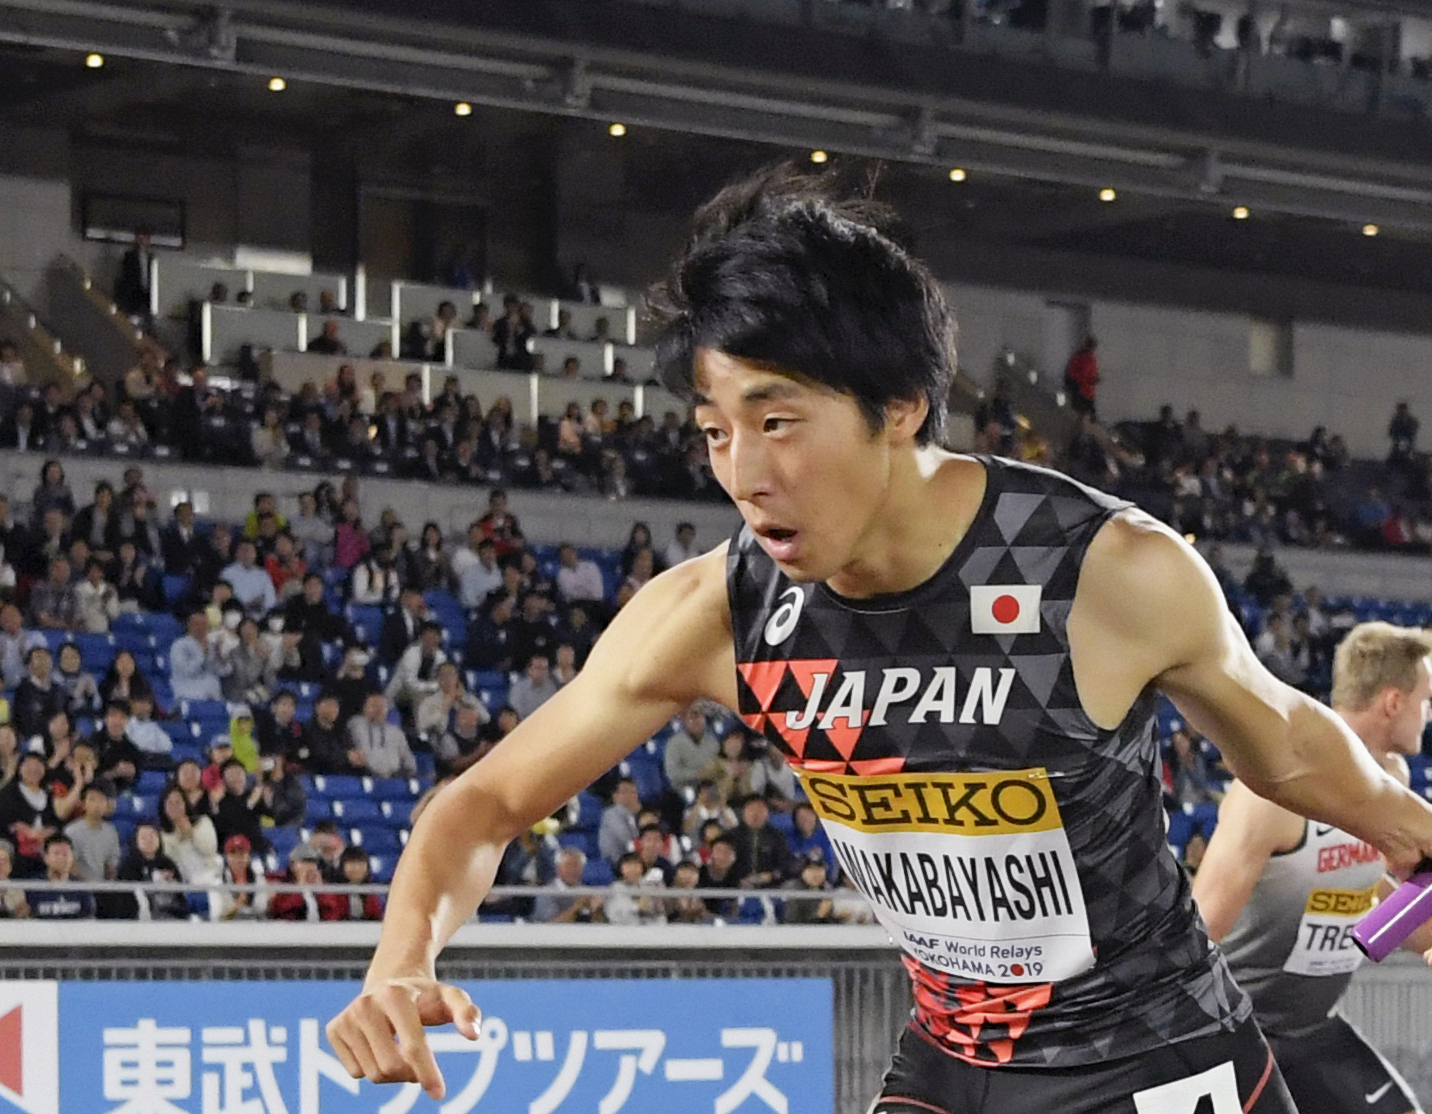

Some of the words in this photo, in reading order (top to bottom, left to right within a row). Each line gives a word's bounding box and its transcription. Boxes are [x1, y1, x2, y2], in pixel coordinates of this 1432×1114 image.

[785, 667, 1015, 730] JAPAN
[809, 776, 1047, 826] SEIKO
[833, 838, 1073, 922] WAKABAYASHI
[903, 931, 939, 949] IAAF
[945, 941, 986, 957] World
[990, 946, 1043, 960] Relays
